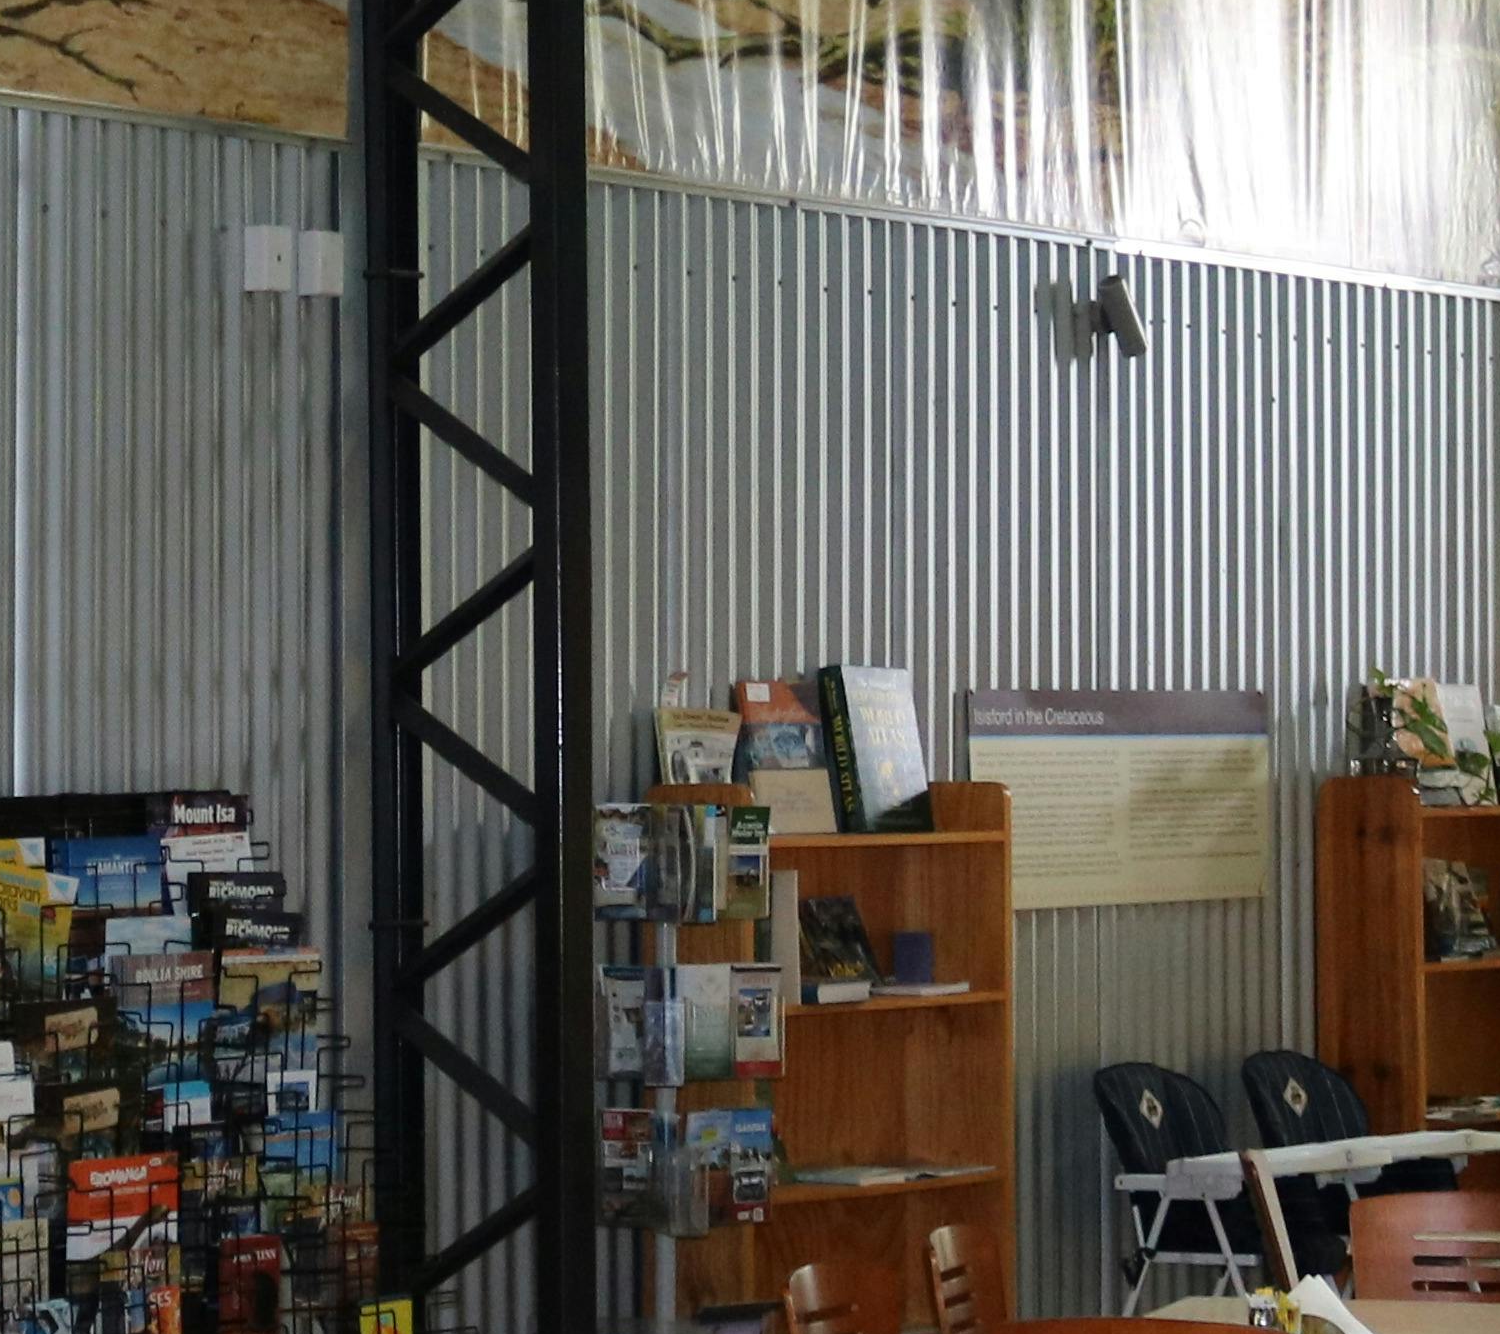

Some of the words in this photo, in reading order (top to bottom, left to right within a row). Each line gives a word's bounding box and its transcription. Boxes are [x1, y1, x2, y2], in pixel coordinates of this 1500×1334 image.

[973, 708, 1013, 726] Isisford
[1015, 708, 1025, 725] in
[1026, 708, 1043, 725] the
[1045, 708, 1104, 726] Cretaceous
[174, 804, 214, 824] Mount
[216, 804, 236, 823] Isa
[209, 886, 274, 900] RICHMOND
[225, 925, 290, 940] RICHMOND
[174, 964, 203, 980] SHIRE
